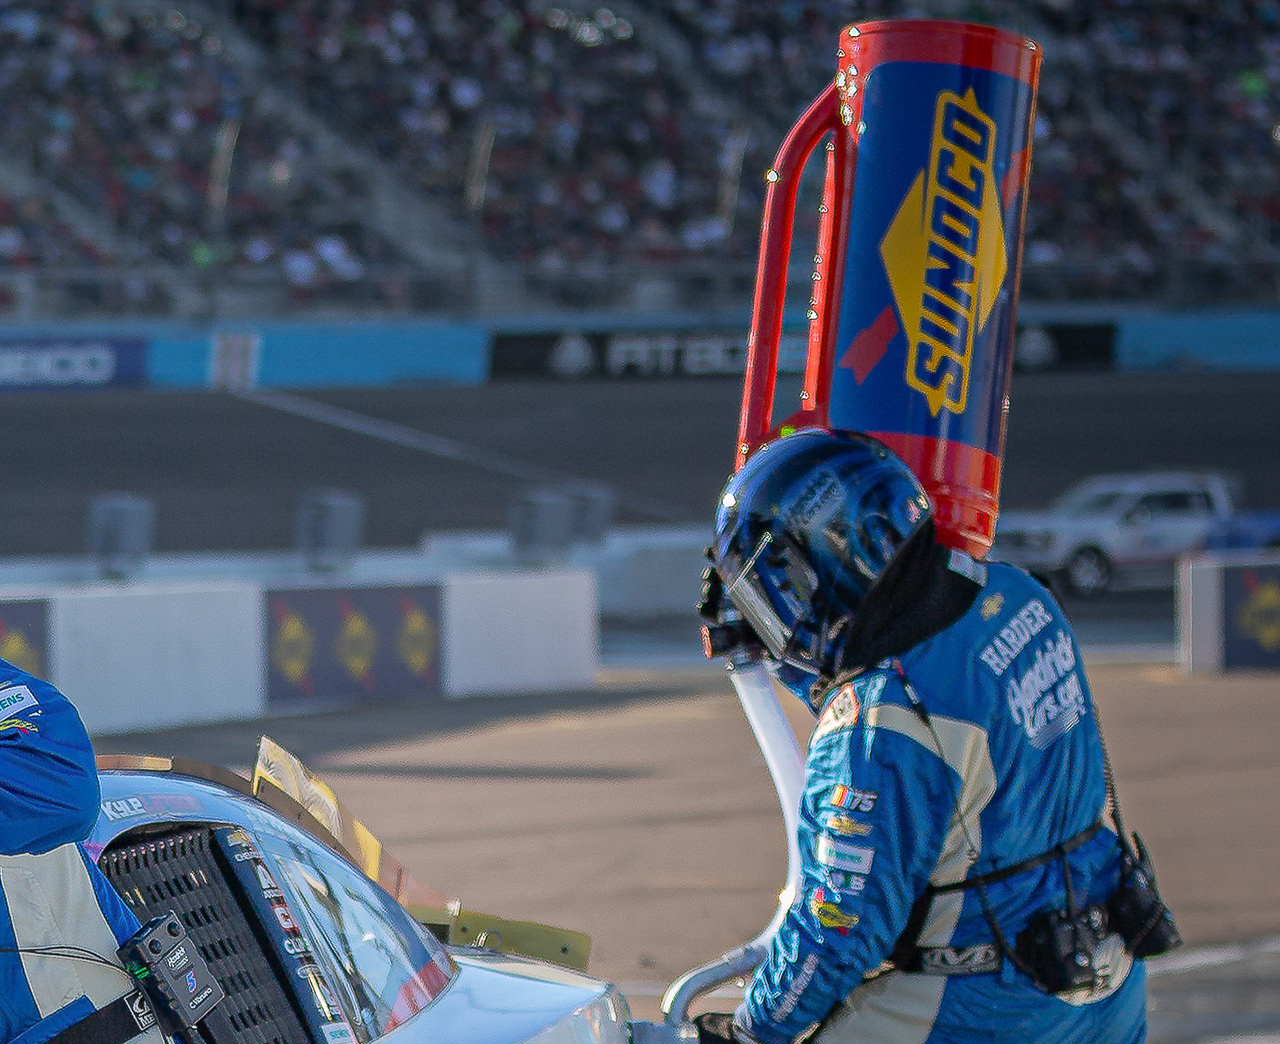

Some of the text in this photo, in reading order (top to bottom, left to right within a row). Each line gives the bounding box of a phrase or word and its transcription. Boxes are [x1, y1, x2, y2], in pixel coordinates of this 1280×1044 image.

[912, 110, 993, 405] SUNOCO
[980, 599, 1053, 677] HARDER
[100, 797, 148, 821] KYLE
[186, 970, 197, 993] 5
